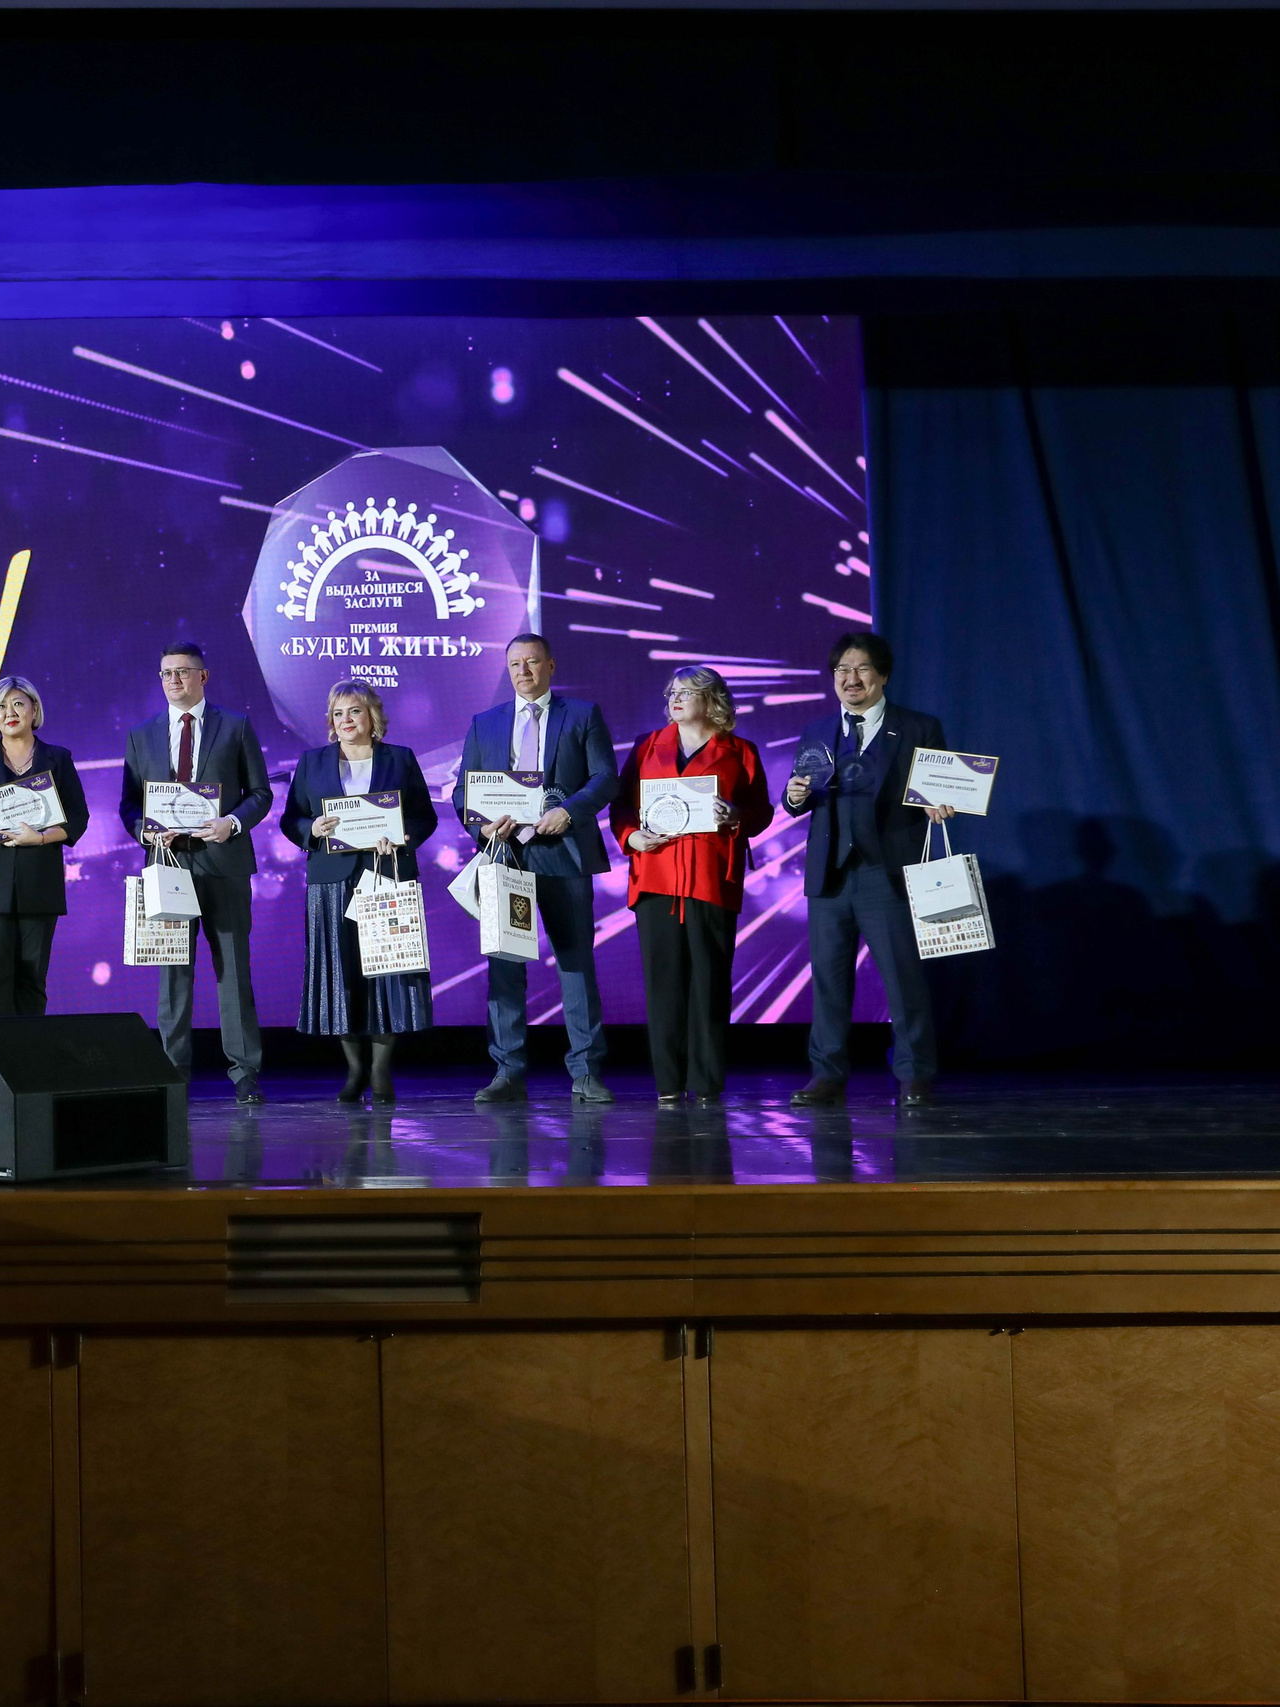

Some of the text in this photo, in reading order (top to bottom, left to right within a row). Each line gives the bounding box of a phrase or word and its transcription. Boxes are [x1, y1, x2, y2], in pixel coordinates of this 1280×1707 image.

[364, 570, 380, 582] ЗА
[325, 581, 424, 597] ВЫДАЮЩИЕСЯ
[344, 596, 403, 609] ЗАСЛУГИ
[349, 622, 398, 634] ПРЕМИЯ
[279, 636, 483, 660] «БУДЕМ ЖИТЬ!»
[350, 664, 399, 676] МОСКВА
[917, 752, 954, 765] ДИПЛОМ
[469, 775, 504, 784] ДИПЛОМ
[148, 784, 182, 794] ДИПЛОМ
[645, 782, 678, 794] ДИПЛОМ
[327, 799, 361, 812] ДИПЛОМ
[510, 917, 531, 930] Libertad
